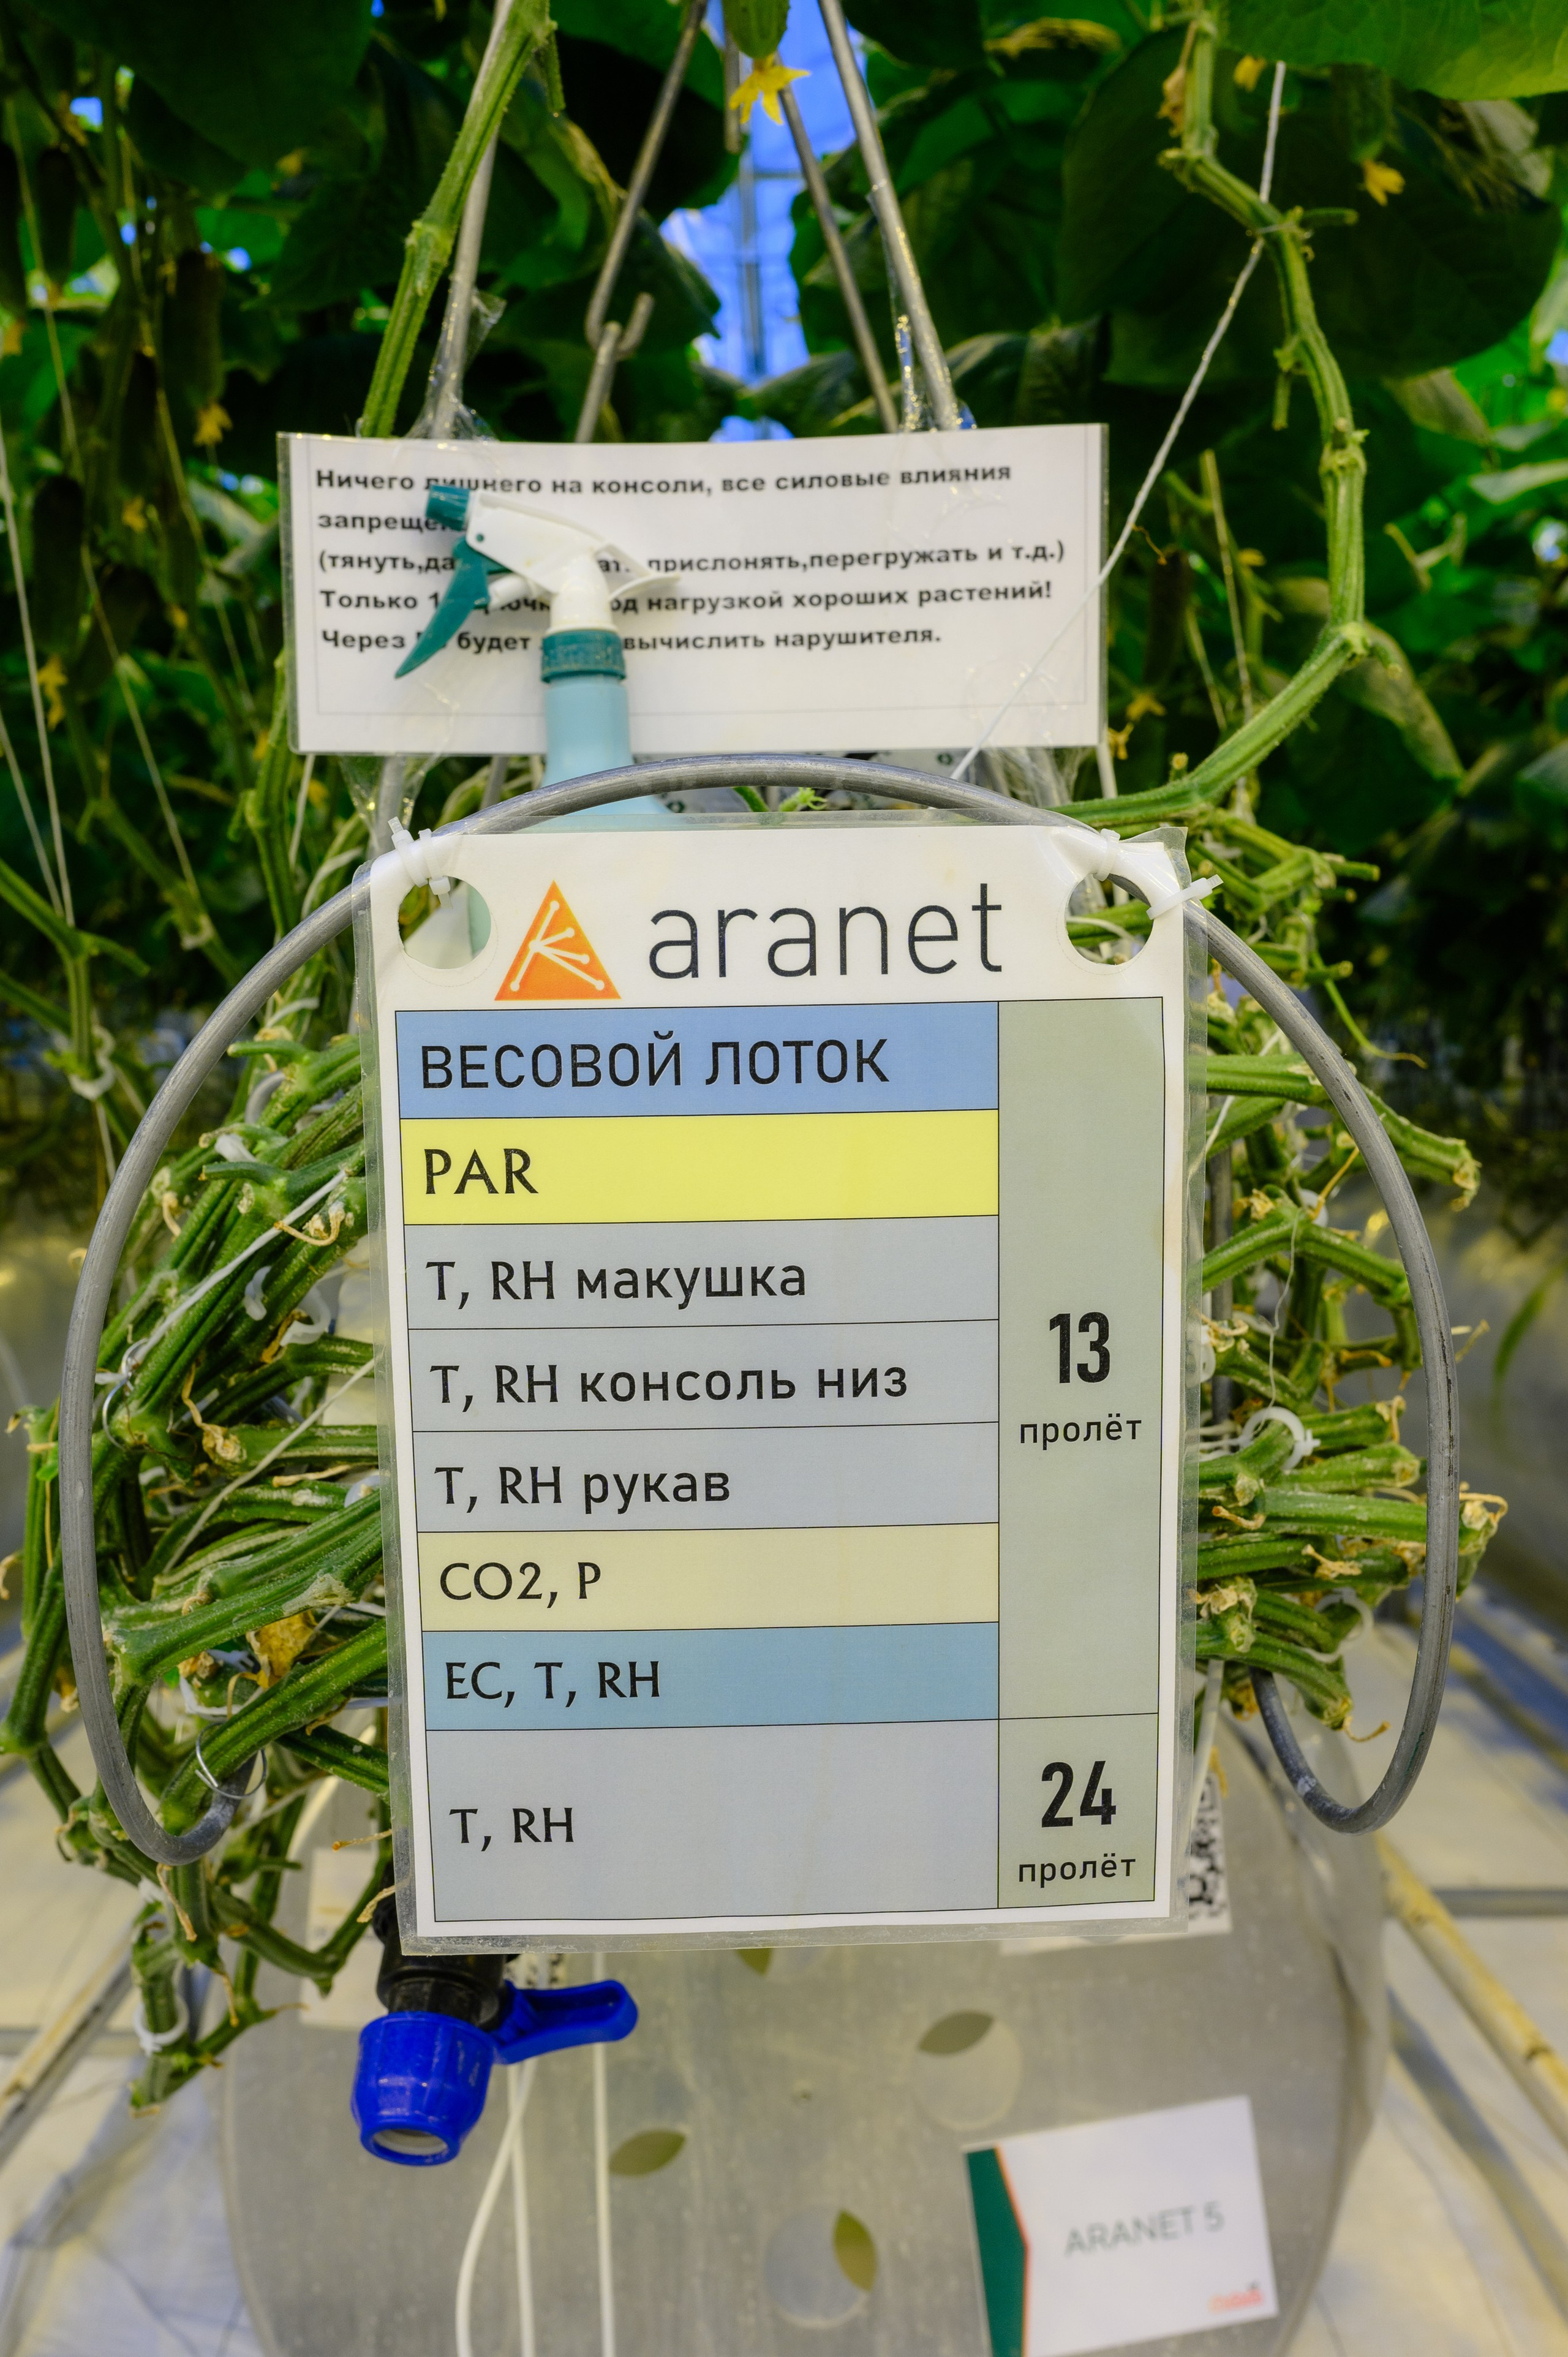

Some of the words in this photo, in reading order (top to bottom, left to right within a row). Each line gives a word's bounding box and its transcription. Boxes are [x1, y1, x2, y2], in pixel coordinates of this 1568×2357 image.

[317, 470, 414, 490] Ничего
[552, 480, 582, 493] на
[592, 480, 711, 494] консоли,
[722, 478, 766, 492] все
[775, 473, 889, 490] силовые
[900, 467, 1010, 484] влияния
[317, 515, 468, 534] запреще
[989, 548, 1002, 560] и
[1012, 540, 1064, 562] т.д.)
[320, 590, 418, 609] Только
[611, 595, 639, 615] од
[644, 591, 782, 614] нагрузкой
[794, 591, 908, 611] хороших
[918, 581, 1051, 608] растений!
[322, 630, 405, 652] Через
[457, 631, 530, 655] будет
[624, 630, 766, 652] вычислить
[775, 630, 940, 651] нарушителя.
[649, 883, 1002, 979] aranet
[421, 1030, 681, 1089] ВЕСОВОЙ
[705, 1038, 890, 1085] ЛОТОК
[424, 1148, 539, 1194] PAR
[425, 1261, 469, 1310] T,
[491, 1261, 555, 1300] RH
[577, 1265, 805, 1310] макушка
[1049, 1311, 1110, 1384] 13
[429, 1365, 473, 1412] T,
[494, 1364, 559, 1403] RH
[581, 1370, 796, 1402] консоль
[818, 1367, 907, 1398] низ
[1020, 1412, 1142, 1450] пролёт
[434, 1466, 478, 1514] T,
[499, 1466, 562, 1504] RH
[584, 1472, 729, 1515] рукав
[440, 1561, 558, 1608] CO2,
[578, 1562, 601, 1599] P
[445, 1661, 515, 1708] EC,
[533, 1662, 576, 1708] T,
[598, 1661, 660, 1699] RH
[1041, 1760, 1117, 1828] 24
[449, 1808, 492, 1852] T,
[512, 1807, 574, 1843] RH
[1019, 1852, 1136, 1888] пролёт
[1065, 2203, 1196, 2257] ARANET
[1204, 2200, 1225, 2233] 5
